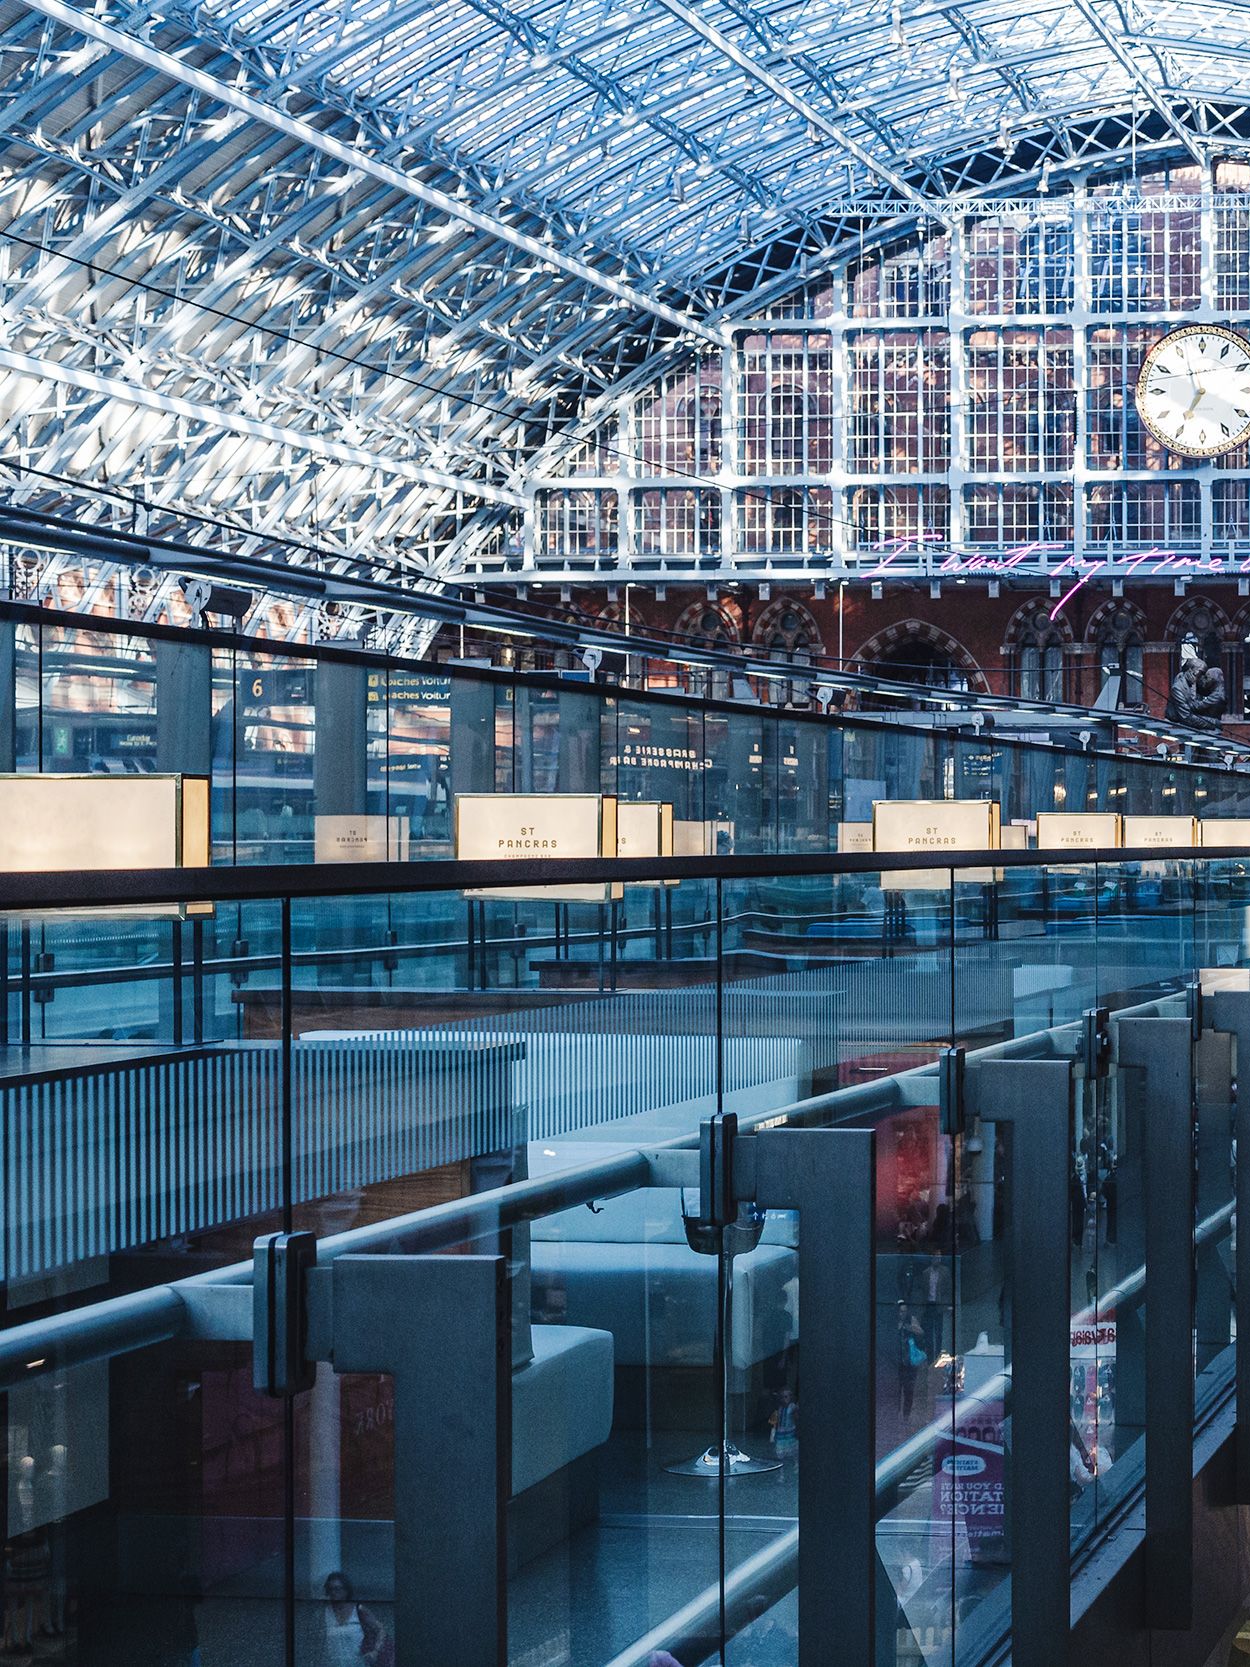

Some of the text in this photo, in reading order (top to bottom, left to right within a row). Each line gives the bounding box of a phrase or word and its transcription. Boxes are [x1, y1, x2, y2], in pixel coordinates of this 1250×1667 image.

[252, 679, 263, 698] 6
[520, 827, 535, 836] ST
[926, 827, 938, 835] ST
[498, 839, 558, 849] PANCRAS
[908, 837, 956, 845] PANCRAS
